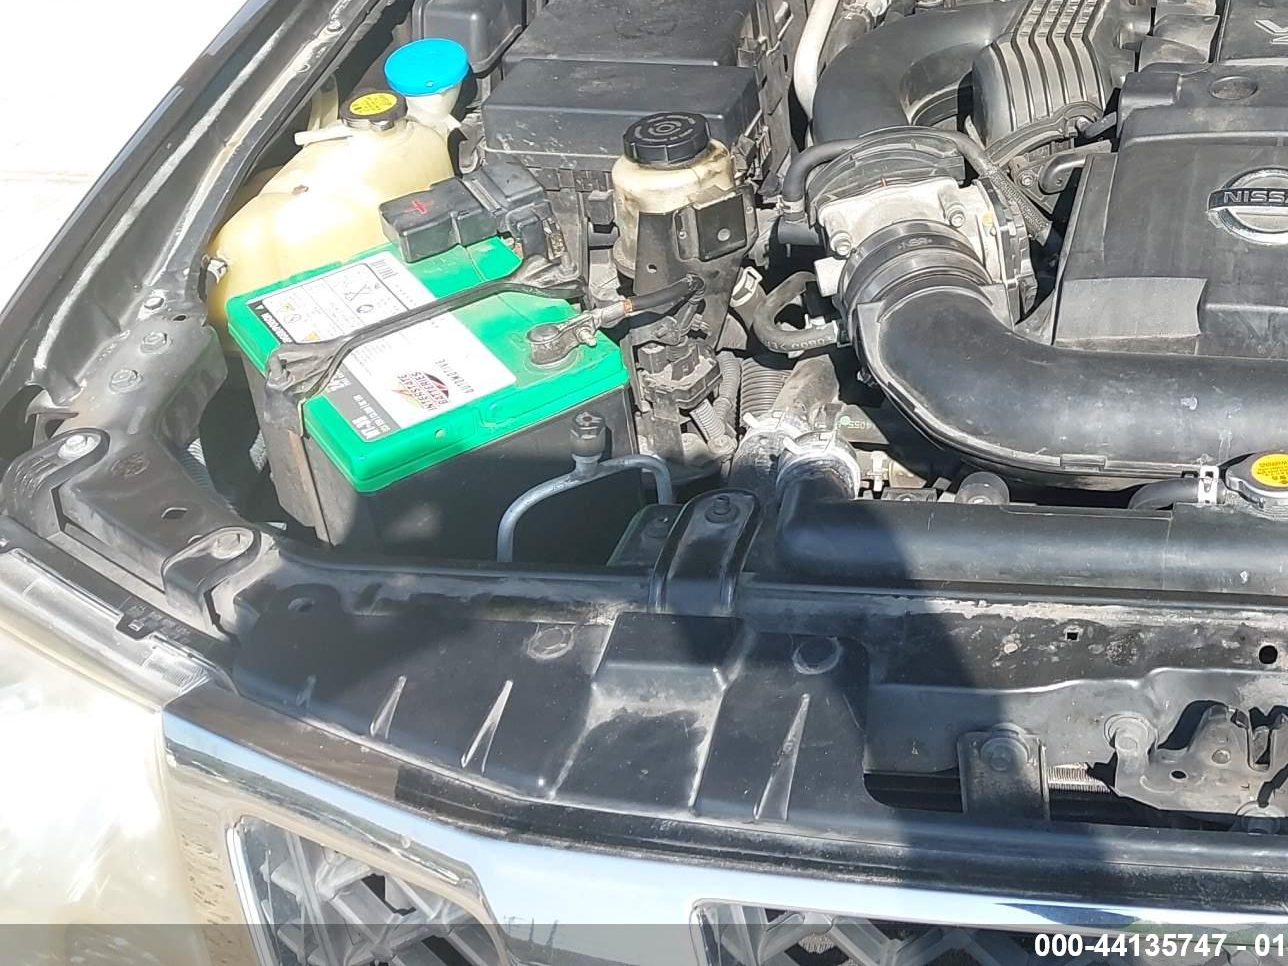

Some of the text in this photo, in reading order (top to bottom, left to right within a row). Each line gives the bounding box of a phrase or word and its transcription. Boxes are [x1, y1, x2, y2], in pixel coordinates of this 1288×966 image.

[397, 374, 437, 410] INTERSTATE
[411, 371, 449, 405] BATTERIES
[435, 359, 475, 394] AUTOMOTIVE
